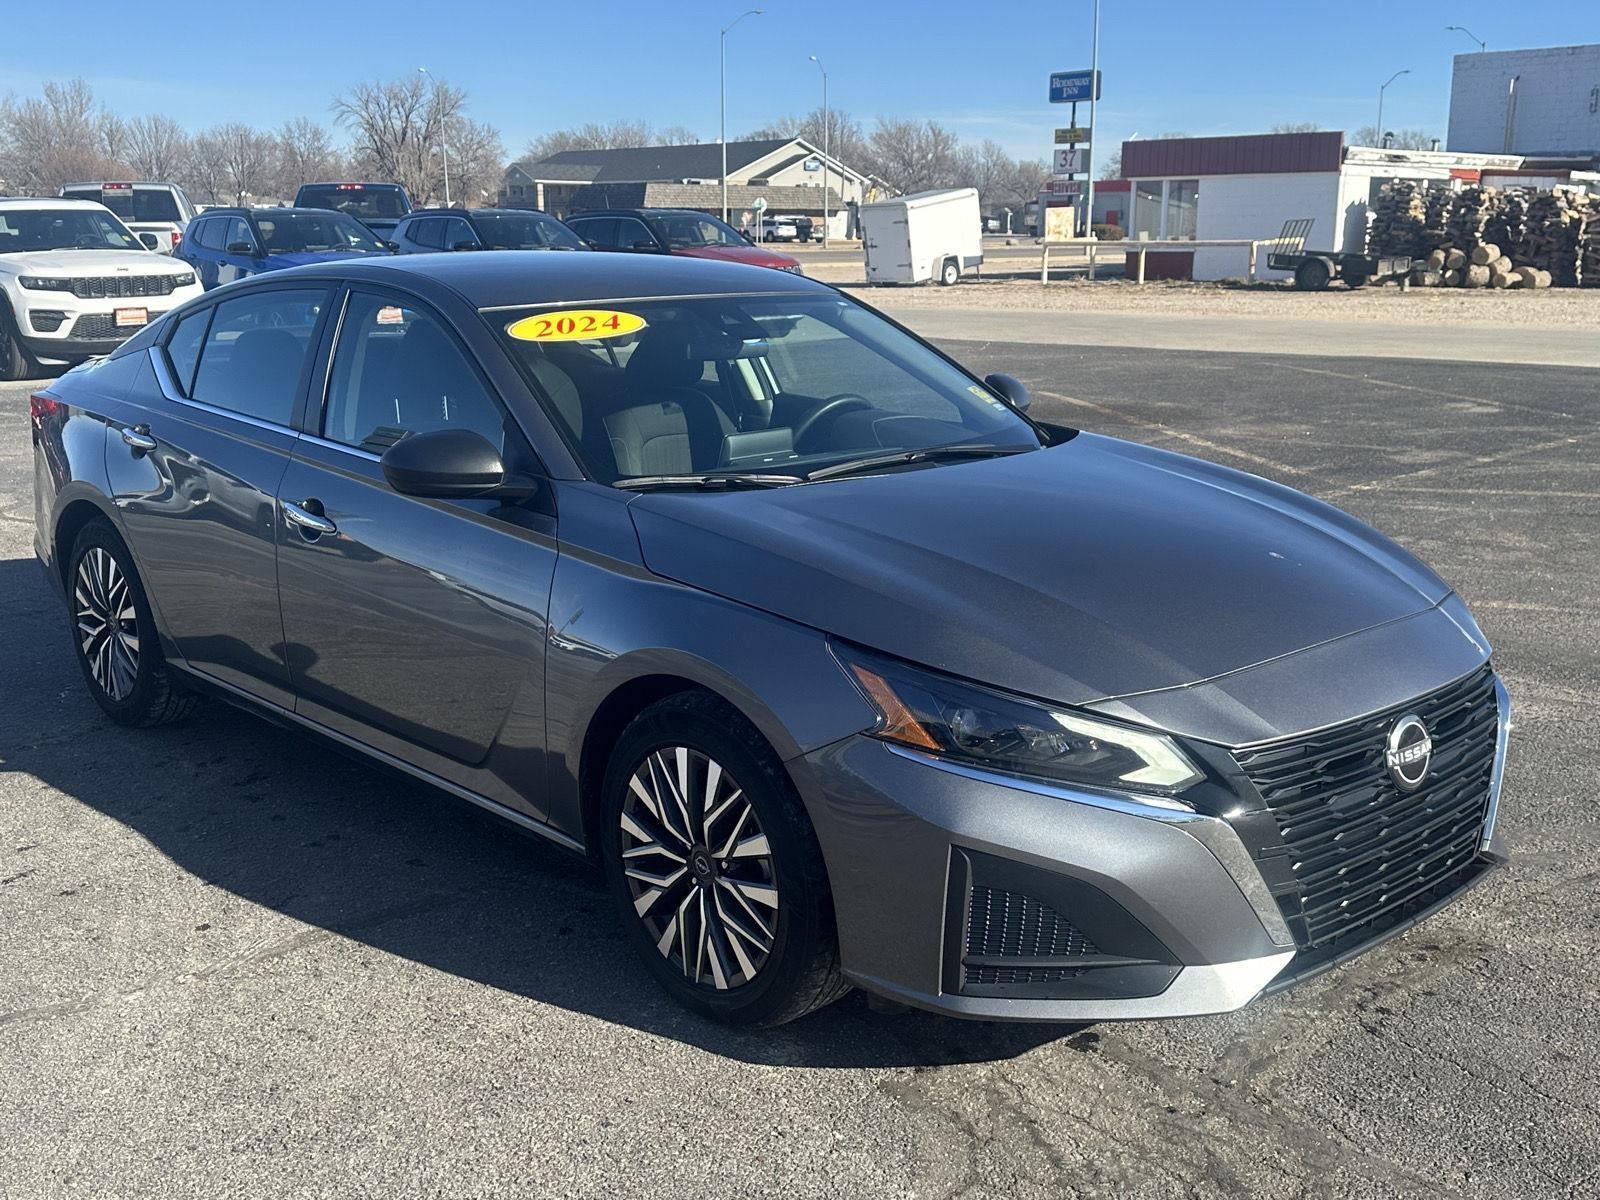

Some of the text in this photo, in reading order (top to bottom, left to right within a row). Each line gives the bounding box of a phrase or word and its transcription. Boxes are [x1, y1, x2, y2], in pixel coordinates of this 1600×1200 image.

[1062, 87, 1079, 97] INN
[1060, 151, 1076, 168] 37
[535, 314, 621, 338] 2024
[1388, 740, 1431, 765] NISSAN
